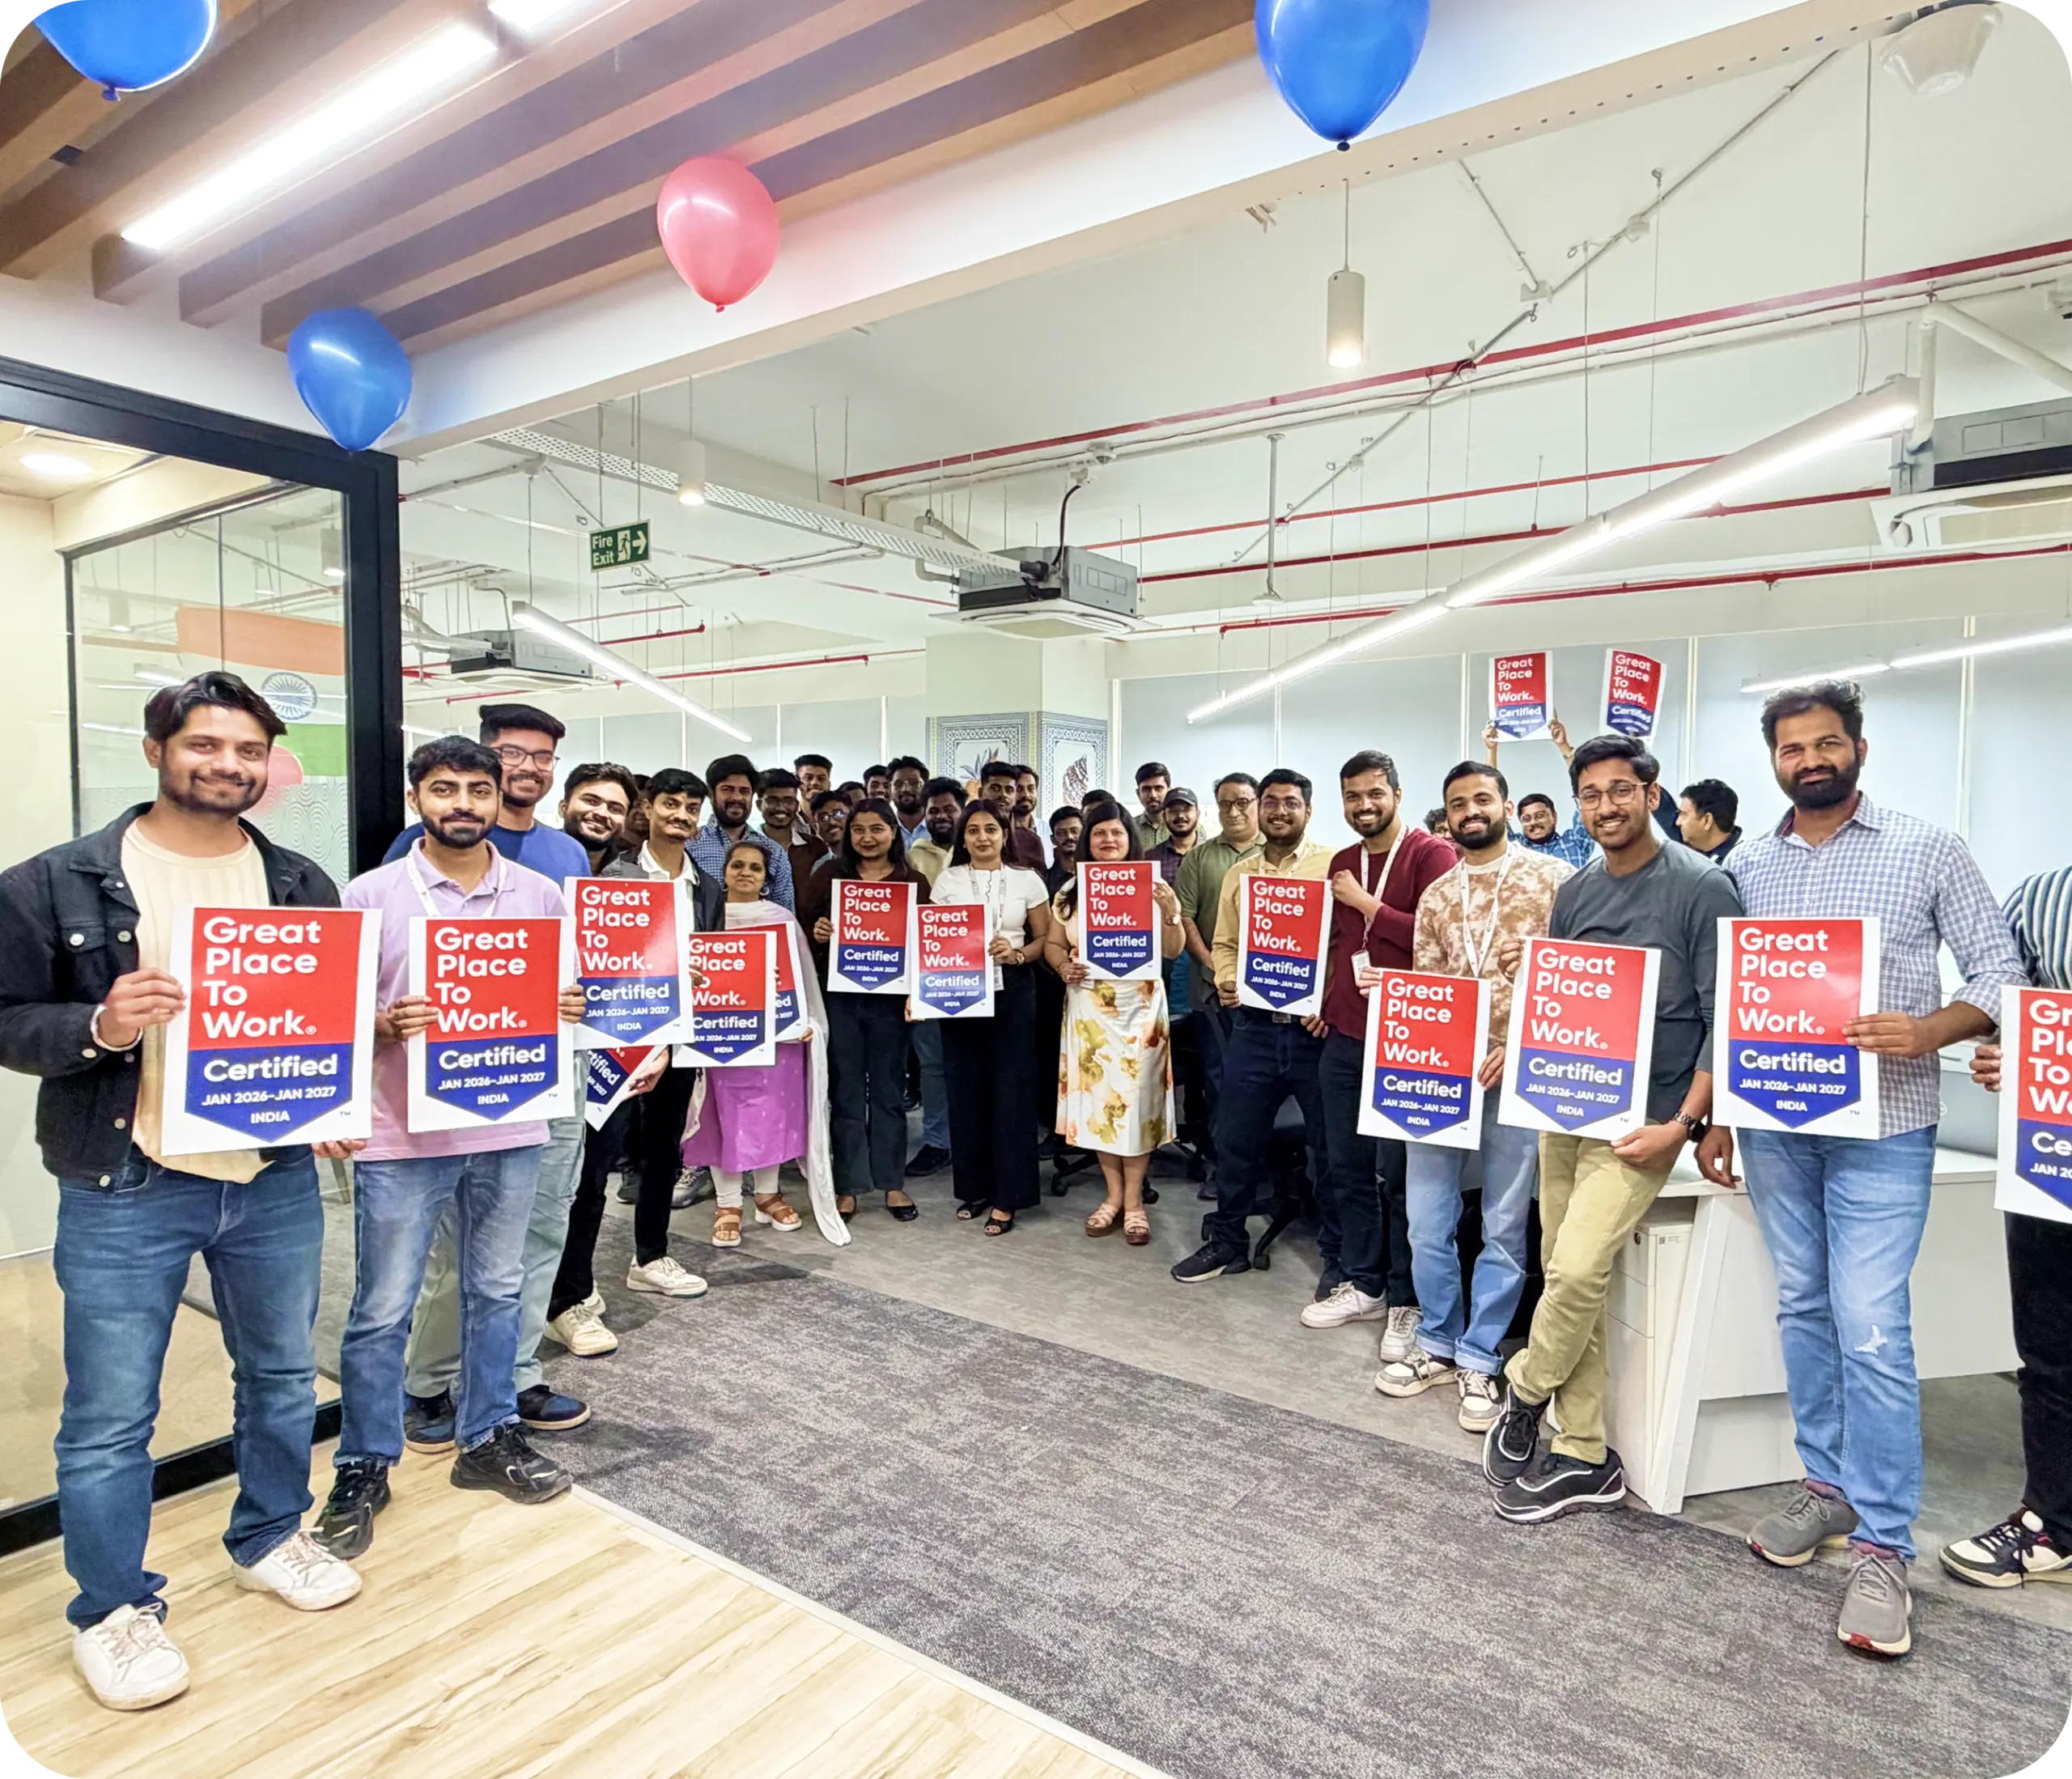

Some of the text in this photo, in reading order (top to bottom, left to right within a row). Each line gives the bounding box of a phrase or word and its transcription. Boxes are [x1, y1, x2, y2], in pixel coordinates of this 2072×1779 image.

[592, 535, 613, 550] Fire
[593, 550, 614, 566] Exit
[1497, 658, 1532, 670] Great
[1615, 654, 1650, 672] Great
[1497, 670, 1532, 681] Place
[1613, 677, 1628, 687] To
[1615, 665, 1650, 682] Place
[1497, 681, 1511, 691] To
[1499, 707, 1541, 717] Certified
[1089, 868, 1136, 881] Great
[582, 886, 650, 906] Great
[844, 885, 891, 898] Great
[1091, 882, 1136, 895] Place
[1253, 881, 1306, 900] Great
[845, 898, 890, 912] Place
[1090, 898, 1107, 911] To
[1253, 897, 1304, 917] Place
[584, 909, 650, 927] Place
[843, 912, 861, 924] To
[922, 910, 968, 923] Great
[1253, 915, 1272, 930] To
[204, 916, 321, 944] Great
[923, 924, 967, 937] Place
[435, 927, 528, 951] Great
[581, 931, 608, 948] To
[689, 939, 745, 953] Great
[923, 940, 940, 952] To
[1093, 936, 1146, 946] Certified
[1739, 928, 1828, 951] Great
[206, 948, 317, 974] Place
[690, 956, 745, 970] Place
[844, 949, 898, 962] Certified
[1537, 948, 1616, 976] Great
[438, 954, 526, 978] Place
[1253, 957, 1310, 977] Certified
[1742, 954, 1827, 978] Place
[699, 976, 711, 988] o
[925, 975, 979, 988] Certified
[1387, 978, 1454, 1002] Great
[1535, 971, 1612, 1000] Place
[202, 980, 247, 1006] To
[435, 983, 471, 1004] To
[587, 984, 669, 1001] Certified
[1739, 981, 1770, 1004] To
[650, 1006, 669, 1014] 2027
[1387, 999, 1451, 1023] Place
[1533, 996, 1561, 1017] To
[617, 1022, 642, 1030] INDIA
[693, 1017, 757, 1029] Certified
[1385, 1021, 1409, 1040] To
[2032, 1028, 2072, 1055] Pl
[439, 1044, 545, 1069] Certified
[1740, 1049, 1845, 1074] Certified
[204, 1054, 338, 1081] Certified
[590, 1053, 620, 1085] tified
[1529, 1058, 1622, 1085] Certified
[2028, 1057, 2070, 1085] To
[439, 1079, 461, 1089] JAN
[520, 1072, 545, 1082] 2027
[1383, 1075, 1462, 1098] Certified
[1739, 1079, 1761, 1089] JAN
[1819, 1084, 1846, 1094] 2027
[202, 1091, 231, 1106] JAN
[305, 1086, 337, 1098] 2027
[478, 1093, 509, 1105] INDIA
[1526, 1084, 1546, 1093] JAN
[1596, 1093, 1620, 1103] 2027
[1382, 1098, 1398, 1106] JAN
[1440, 1104, 1460, 1114] 2027
[1556, 1105, 1583, 1116] INDIA
[1777, 1101, 1807, 1111] INDIA
[251, 1110, 290, 1123] INDIA
[1408, 1116, 1430, 1126] INDIA
[2030, 1163, 2057, 1176] JAN
